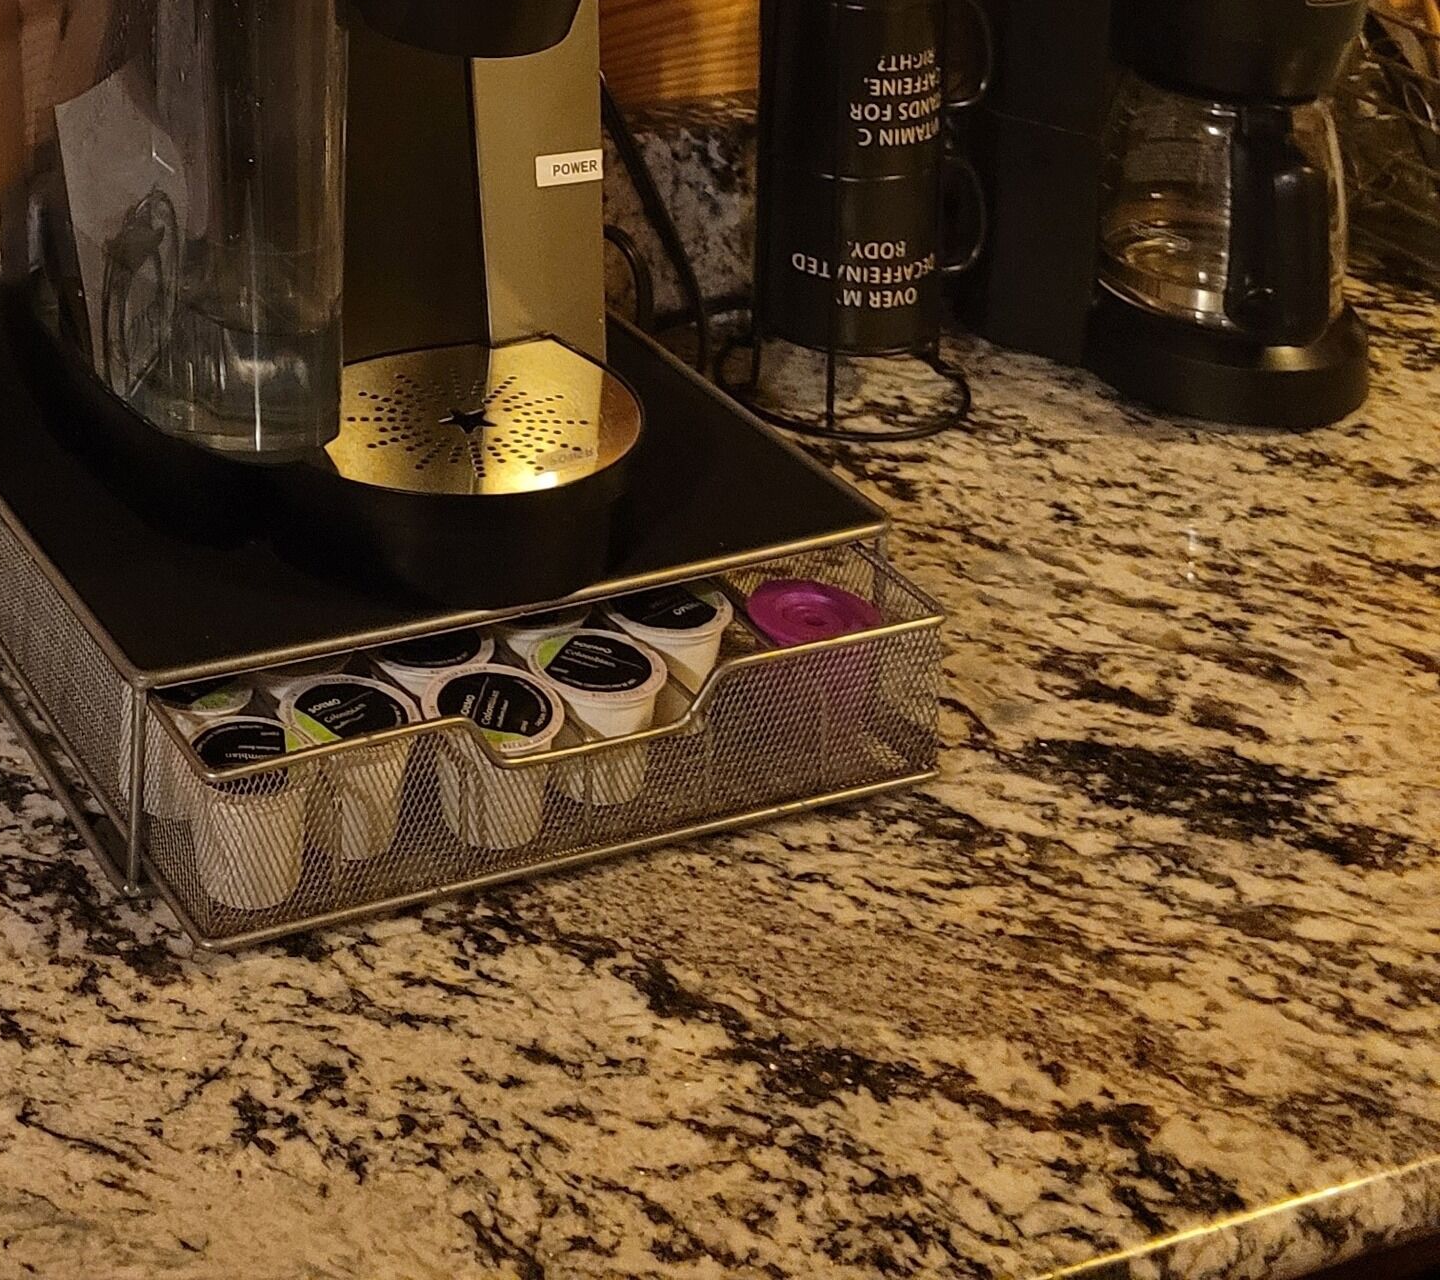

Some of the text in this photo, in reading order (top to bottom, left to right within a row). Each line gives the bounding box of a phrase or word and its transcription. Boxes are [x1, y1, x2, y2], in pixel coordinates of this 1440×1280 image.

[850, 102, 892, 122] FOR
[857, 128, 873, 146] C
[552, 160, 598, 176] POWER
[847, 240, 906, 260] BODY.
[792, 252, 936, 284] DECAFFEINTED
[836, 286, 918, 308] OVER M
